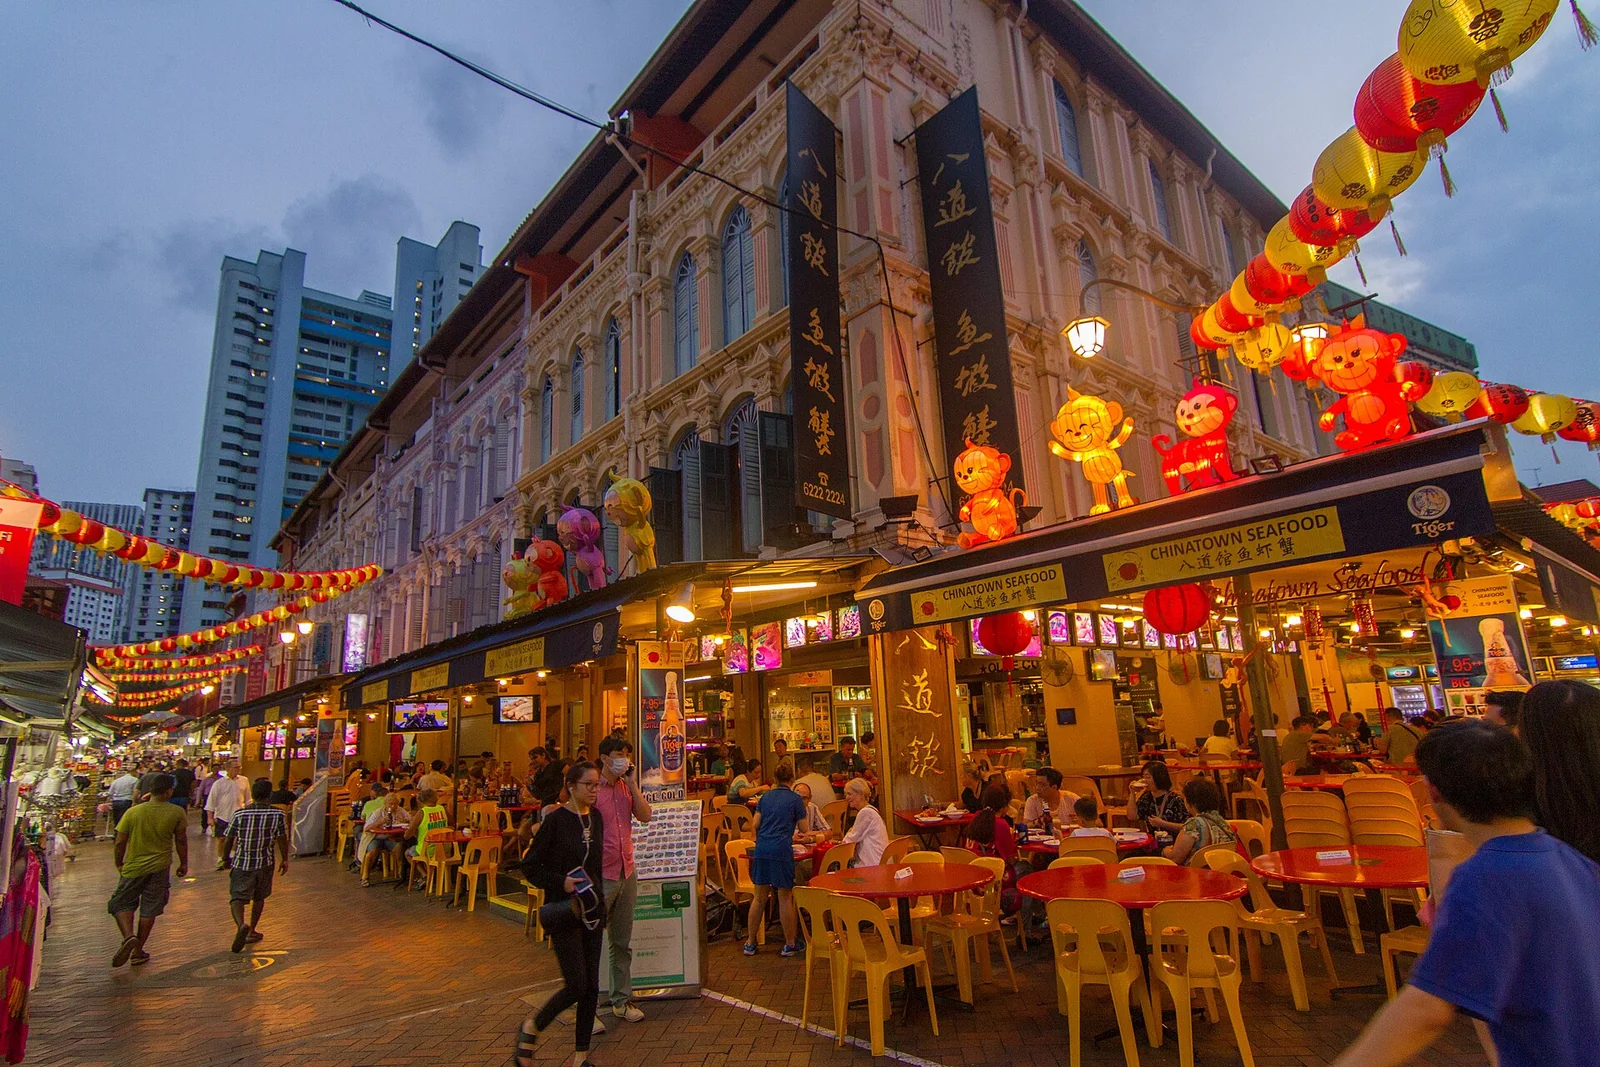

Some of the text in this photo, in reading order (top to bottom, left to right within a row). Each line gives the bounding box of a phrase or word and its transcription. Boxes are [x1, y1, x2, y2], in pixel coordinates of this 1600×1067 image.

[803, 481, 846, 506] 6222 2224
[1150, 514, 1328, 561] CHINATOWN SEAFOOD
[1411, 519, 1455, 538] Tiger
[1179, 537, 1295, 572] 八道馆鱼虾蟹
[1326, 550, 1434, 595] Seafood
[942, 569, 1057, 602] CHINATOWN SEAFOOD
[1471, 585, 1508, 594] CHINATOWN
[961, 586, 1037, 611] 八道馆鱼虾蟹
[870, 620, 887, 632] Tiger
[1451, 677, 1471, 688] BIG
[645, 712, 657, 720] BIG
[662, 740, 684, 753] Tiger
[428, 810, 444, 822] FULL
